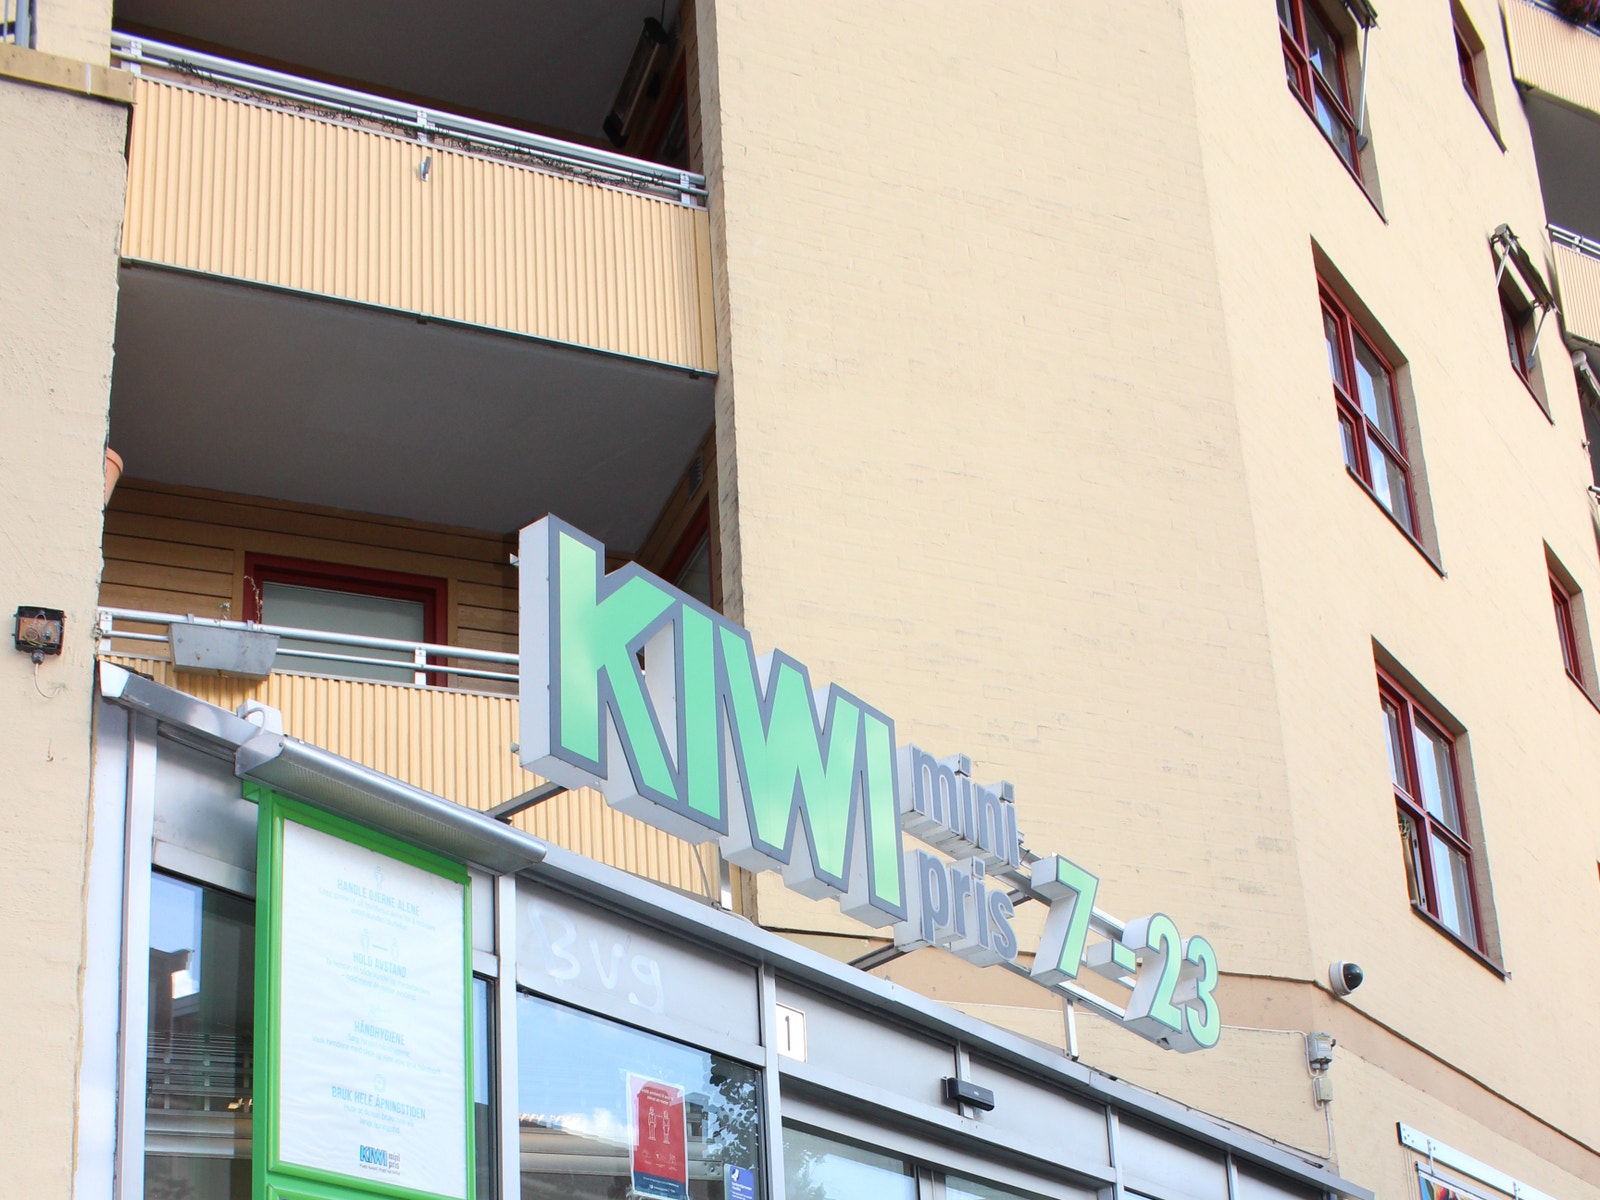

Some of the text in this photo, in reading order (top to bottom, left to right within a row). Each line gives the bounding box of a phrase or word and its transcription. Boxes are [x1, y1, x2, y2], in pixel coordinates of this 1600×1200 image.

[546, 513, 908, 922] KIWI
[908, 743, 1021, 868] mini
[337, 879, 420, 917] HANDLE GJERNE ALENE
[914, 849, 1019, 964] pris
[353, 952, 373, 968] HOLD
[375, 958, 407, 978] AVSTAND
[354, 1019, 405, 1046] HÅNDHYGIENE
[783, 1015, 794, 1051] 1
[332, 1086, 353, 1102] BRUK
[354, 1091, 374, 1107] HELE
[375, 1094, 427, 1121] ÅPNINGSTIDEN
[360, 1145, 388, 1167] KIWI
